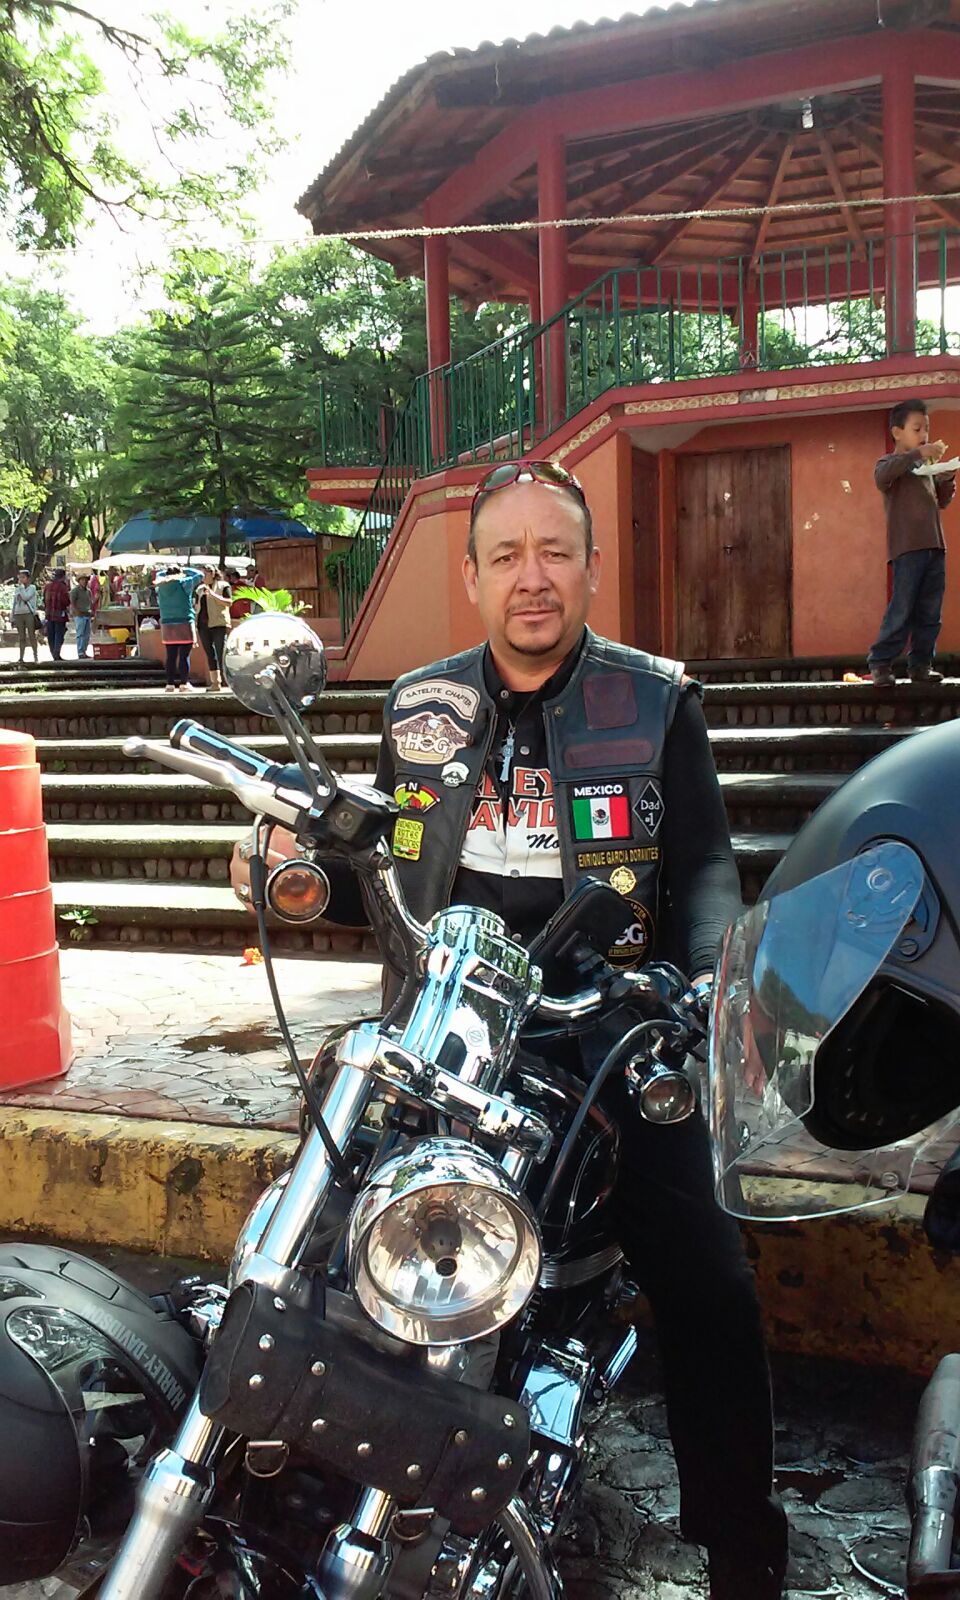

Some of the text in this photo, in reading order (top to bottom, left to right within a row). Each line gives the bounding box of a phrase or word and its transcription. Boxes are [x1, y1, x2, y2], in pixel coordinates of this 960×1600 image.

[405, 687, 443, 699] SATELITE
[404, 732, 450, 754] HOG
[408, 782, 418, 791] N
[574, 784, 623, 797] MEXICO
[640, 799, 660, 810] Dad
[577, 847, 659, 868] ENRIQUE GARCIA DORANTES
[82, 1303, 186, 1411] HARLEY-DAVIDSON
